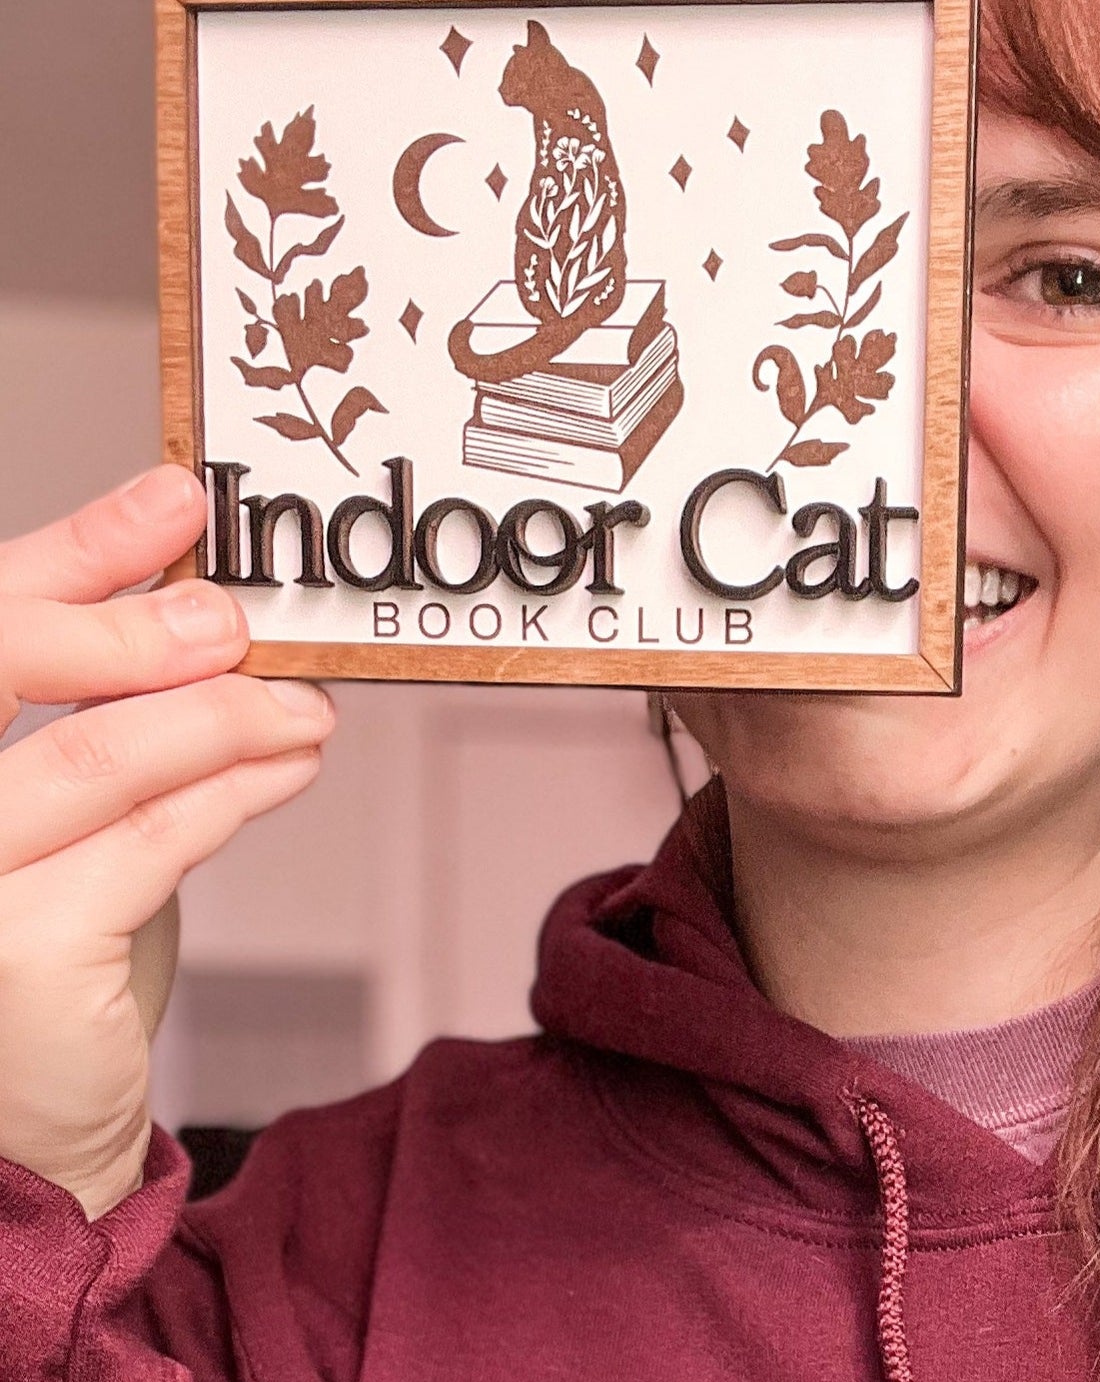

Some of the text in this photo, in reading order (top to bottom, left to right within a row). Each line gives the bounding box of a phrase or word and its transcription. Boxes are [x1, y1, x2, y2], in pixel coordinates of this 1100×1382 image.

[202, 457, 920, 603] Indoor Cat
[372, 601, 754, 645] BOOK CLUB
